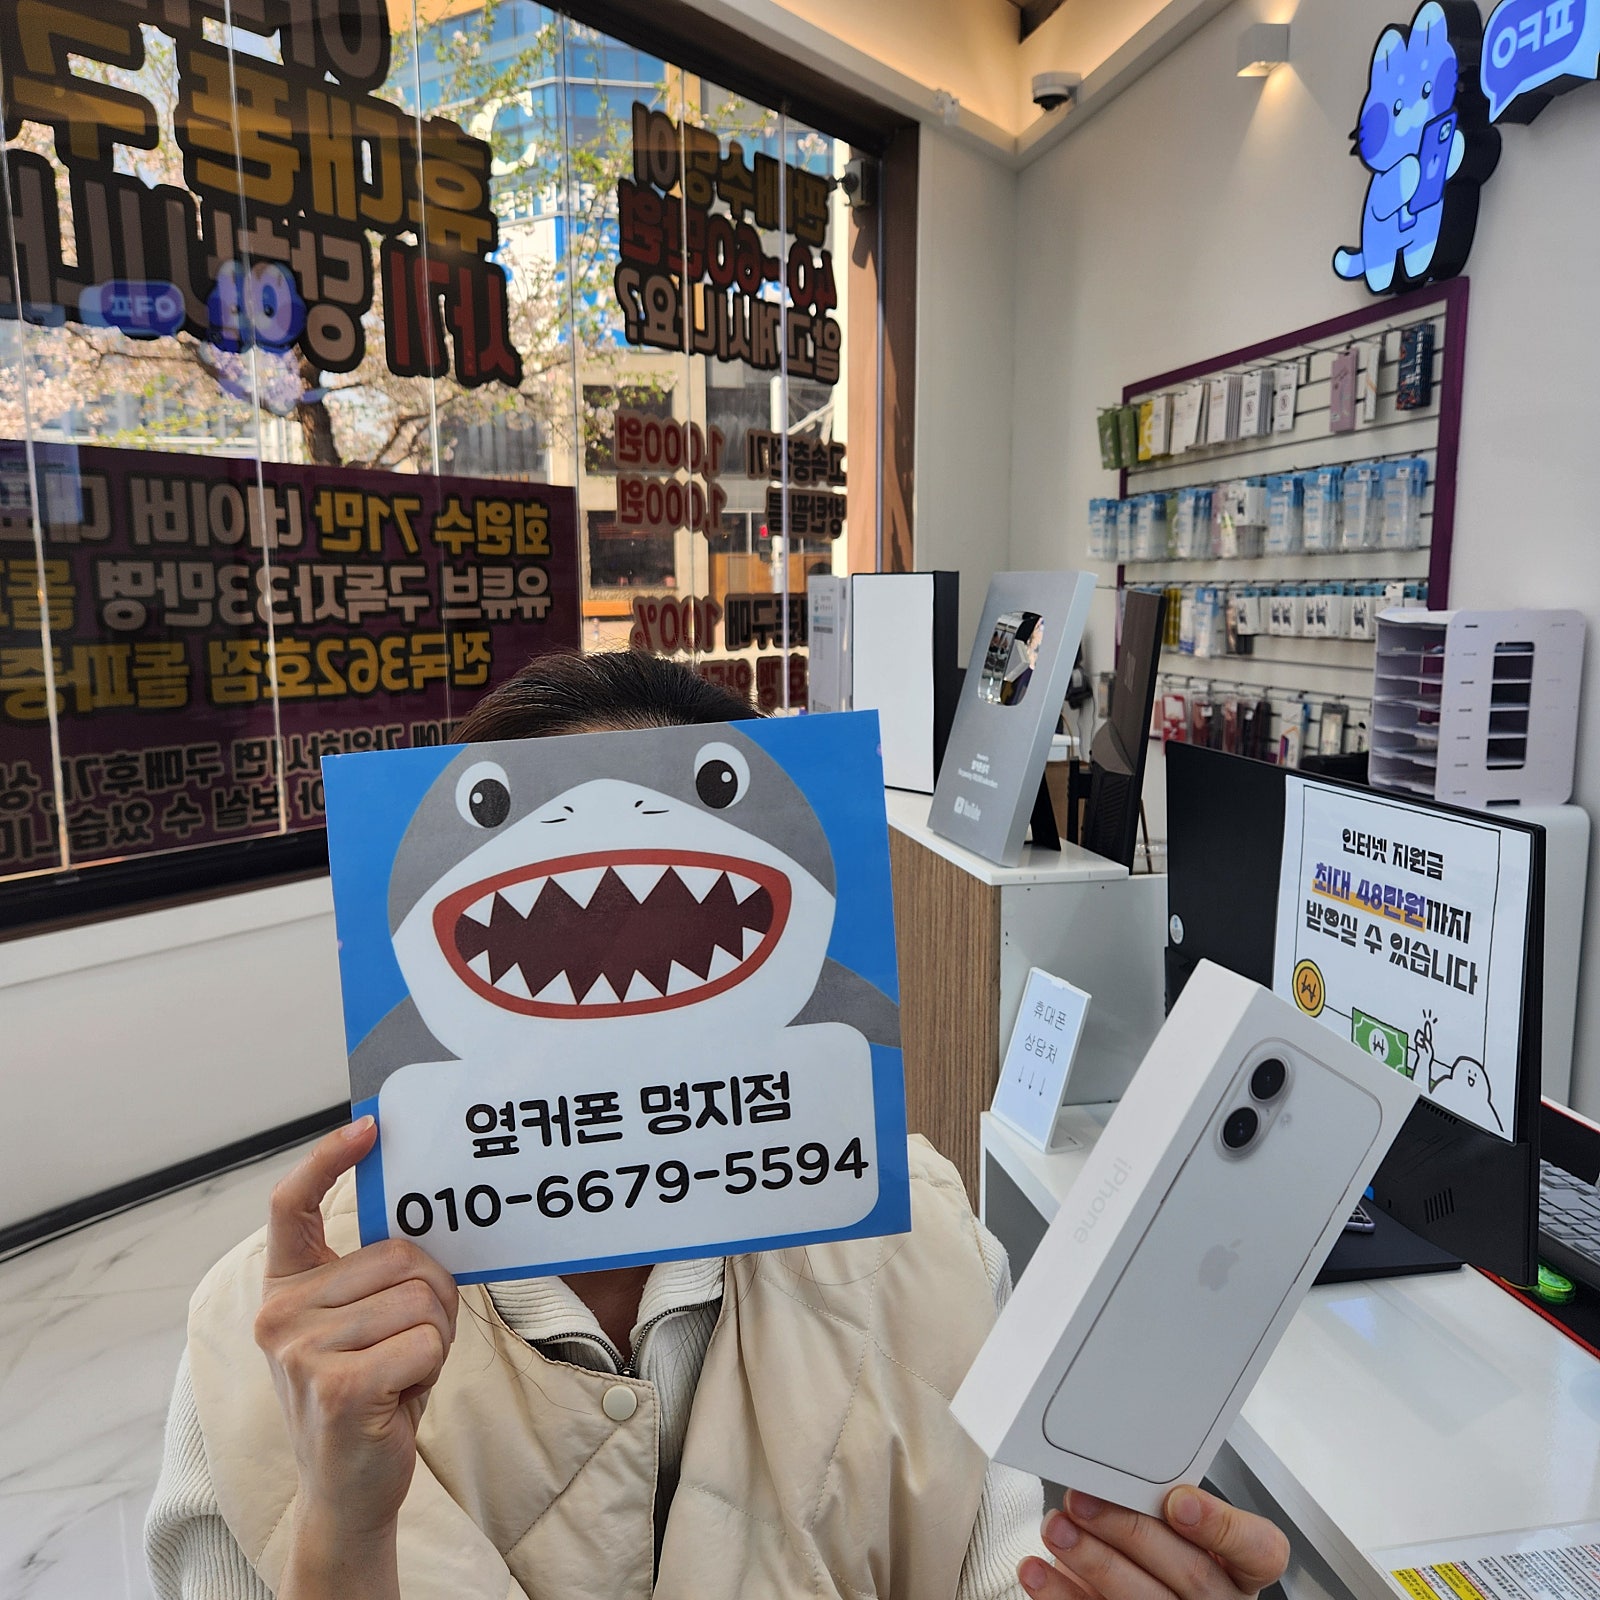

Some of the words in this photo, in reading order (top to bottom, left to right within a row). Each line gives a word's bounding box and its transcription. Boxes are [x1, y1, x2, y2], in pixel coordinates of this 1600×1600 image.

[1342, 828, 1387, 864] 인터넷
[1392, 842, 1444, 881] 지원금
[1314, 862, 1351, 900] 최대
[1356, 878, 1473, 944] 48만원까지
[1306, 899, 1358, 948] 받으실
[1364, 922, 1383, 955] 수
[1389, 932, 1478, 995] 있습니다
[1025, 1033, 1058, 1065] 상담처
[1034, 1001, 1067, 1031] 휴대폰
[465, 1091, 624, 1159] 옆커폰
[640, 1070, 792, 1135] 명지점
[396, 1137, 869, 1237] 010-6679-5594
[1073, 1156, 1133, 1245] iPhone
